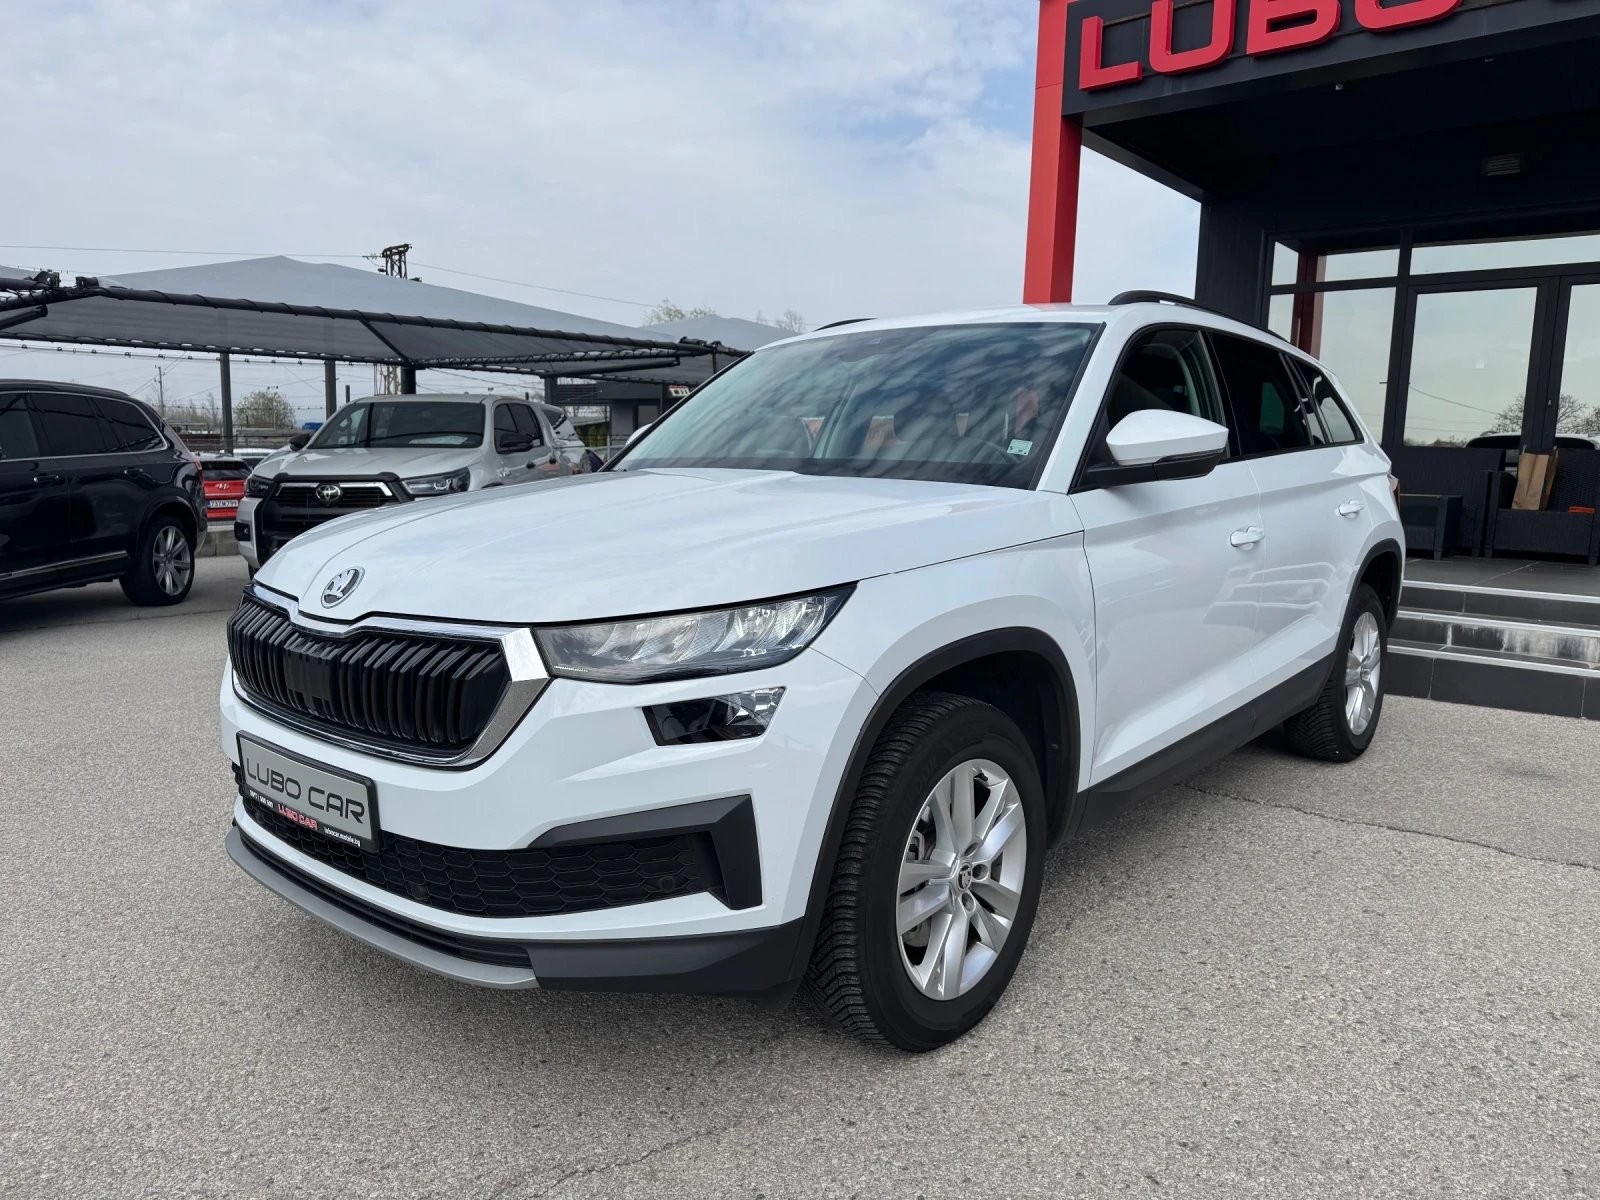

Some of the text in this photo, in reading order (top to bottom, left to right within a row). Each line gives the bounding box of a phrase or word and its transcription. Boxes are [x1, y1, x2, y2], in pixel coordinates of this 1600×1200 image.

[246, 757, 365, 824] LUBO CAR
[298, 814, 318, 831] CAR
